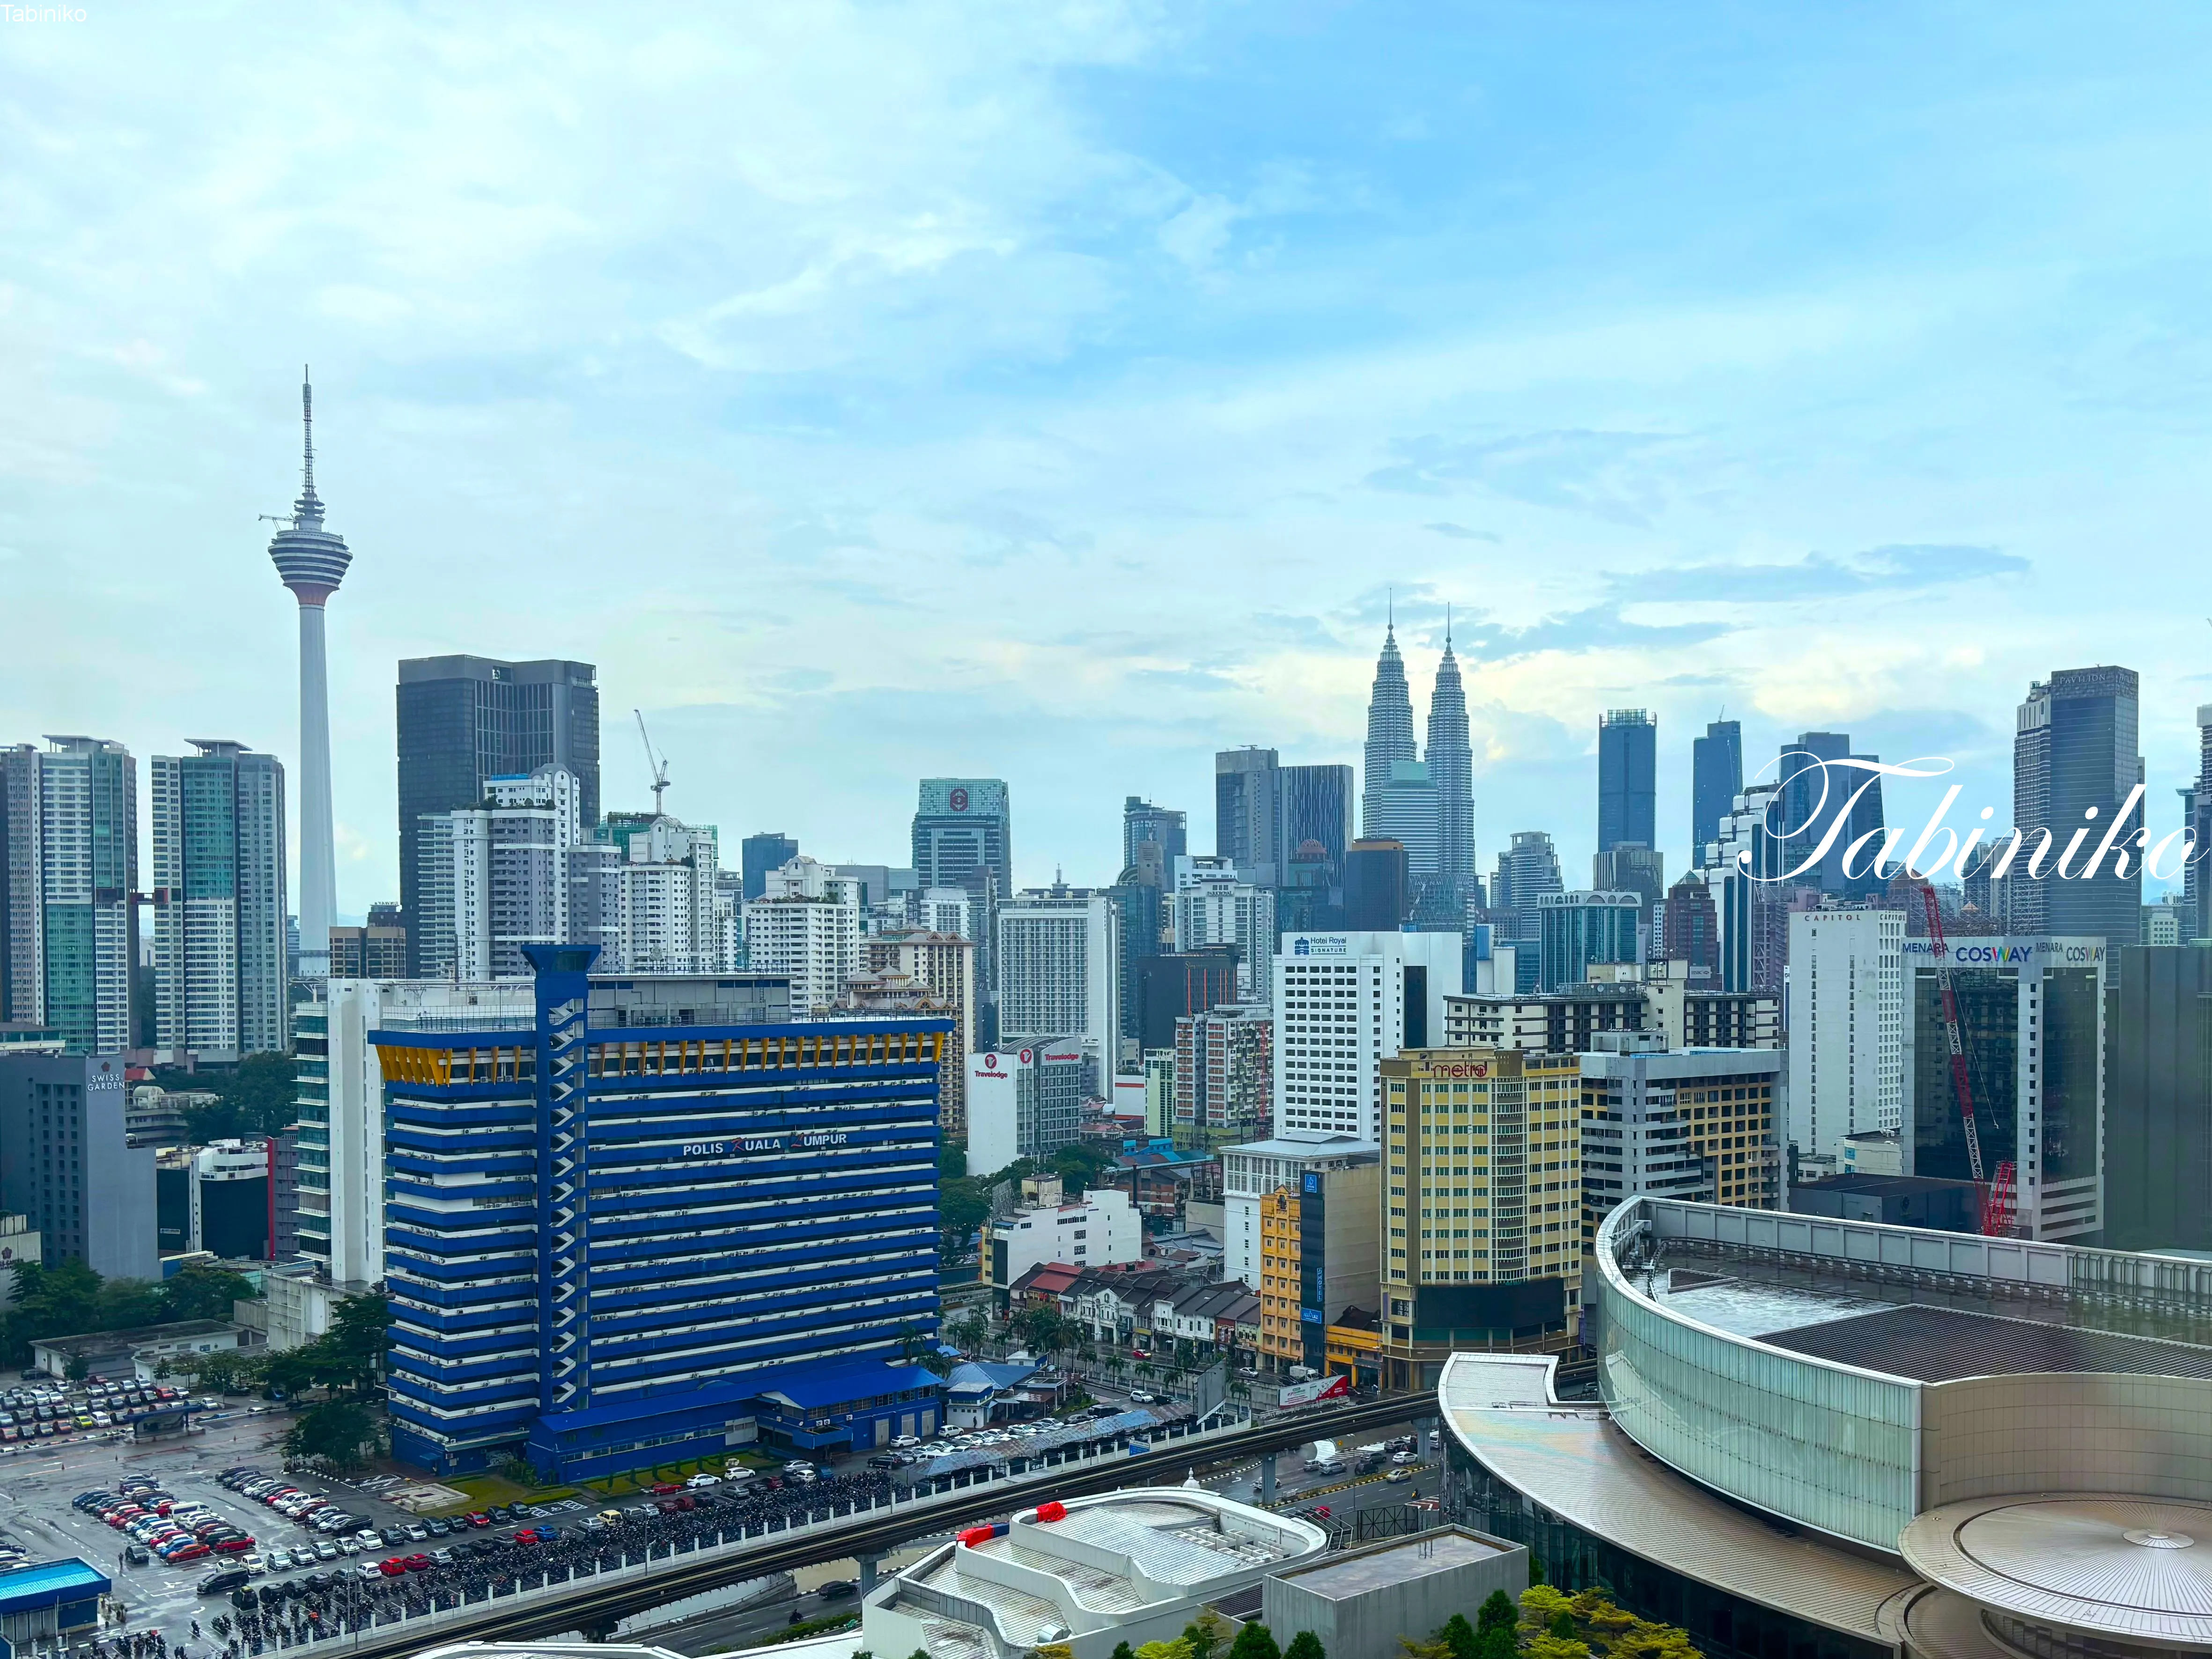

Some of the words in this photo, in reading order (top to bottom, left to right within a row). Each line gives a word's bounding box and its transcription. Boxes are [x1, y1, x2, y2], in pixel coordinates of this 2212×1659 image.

[2060, 674, 2105, 684] PAVILION
[1902, 943, 1950, 952] MENARA
[1956, 946, 2032, 962] COSWAY
[2036, 942, 2063, 952] MENARA
[2067, 946, 2105, 961] COSWAY
[974, 1070, 1008, 1079] Travelodge
[87, 1082, 125, 1091] GARDEN
[683, 1143, 724, 1156] POLIS
[731, 1137, 781, 1151] KUALA
